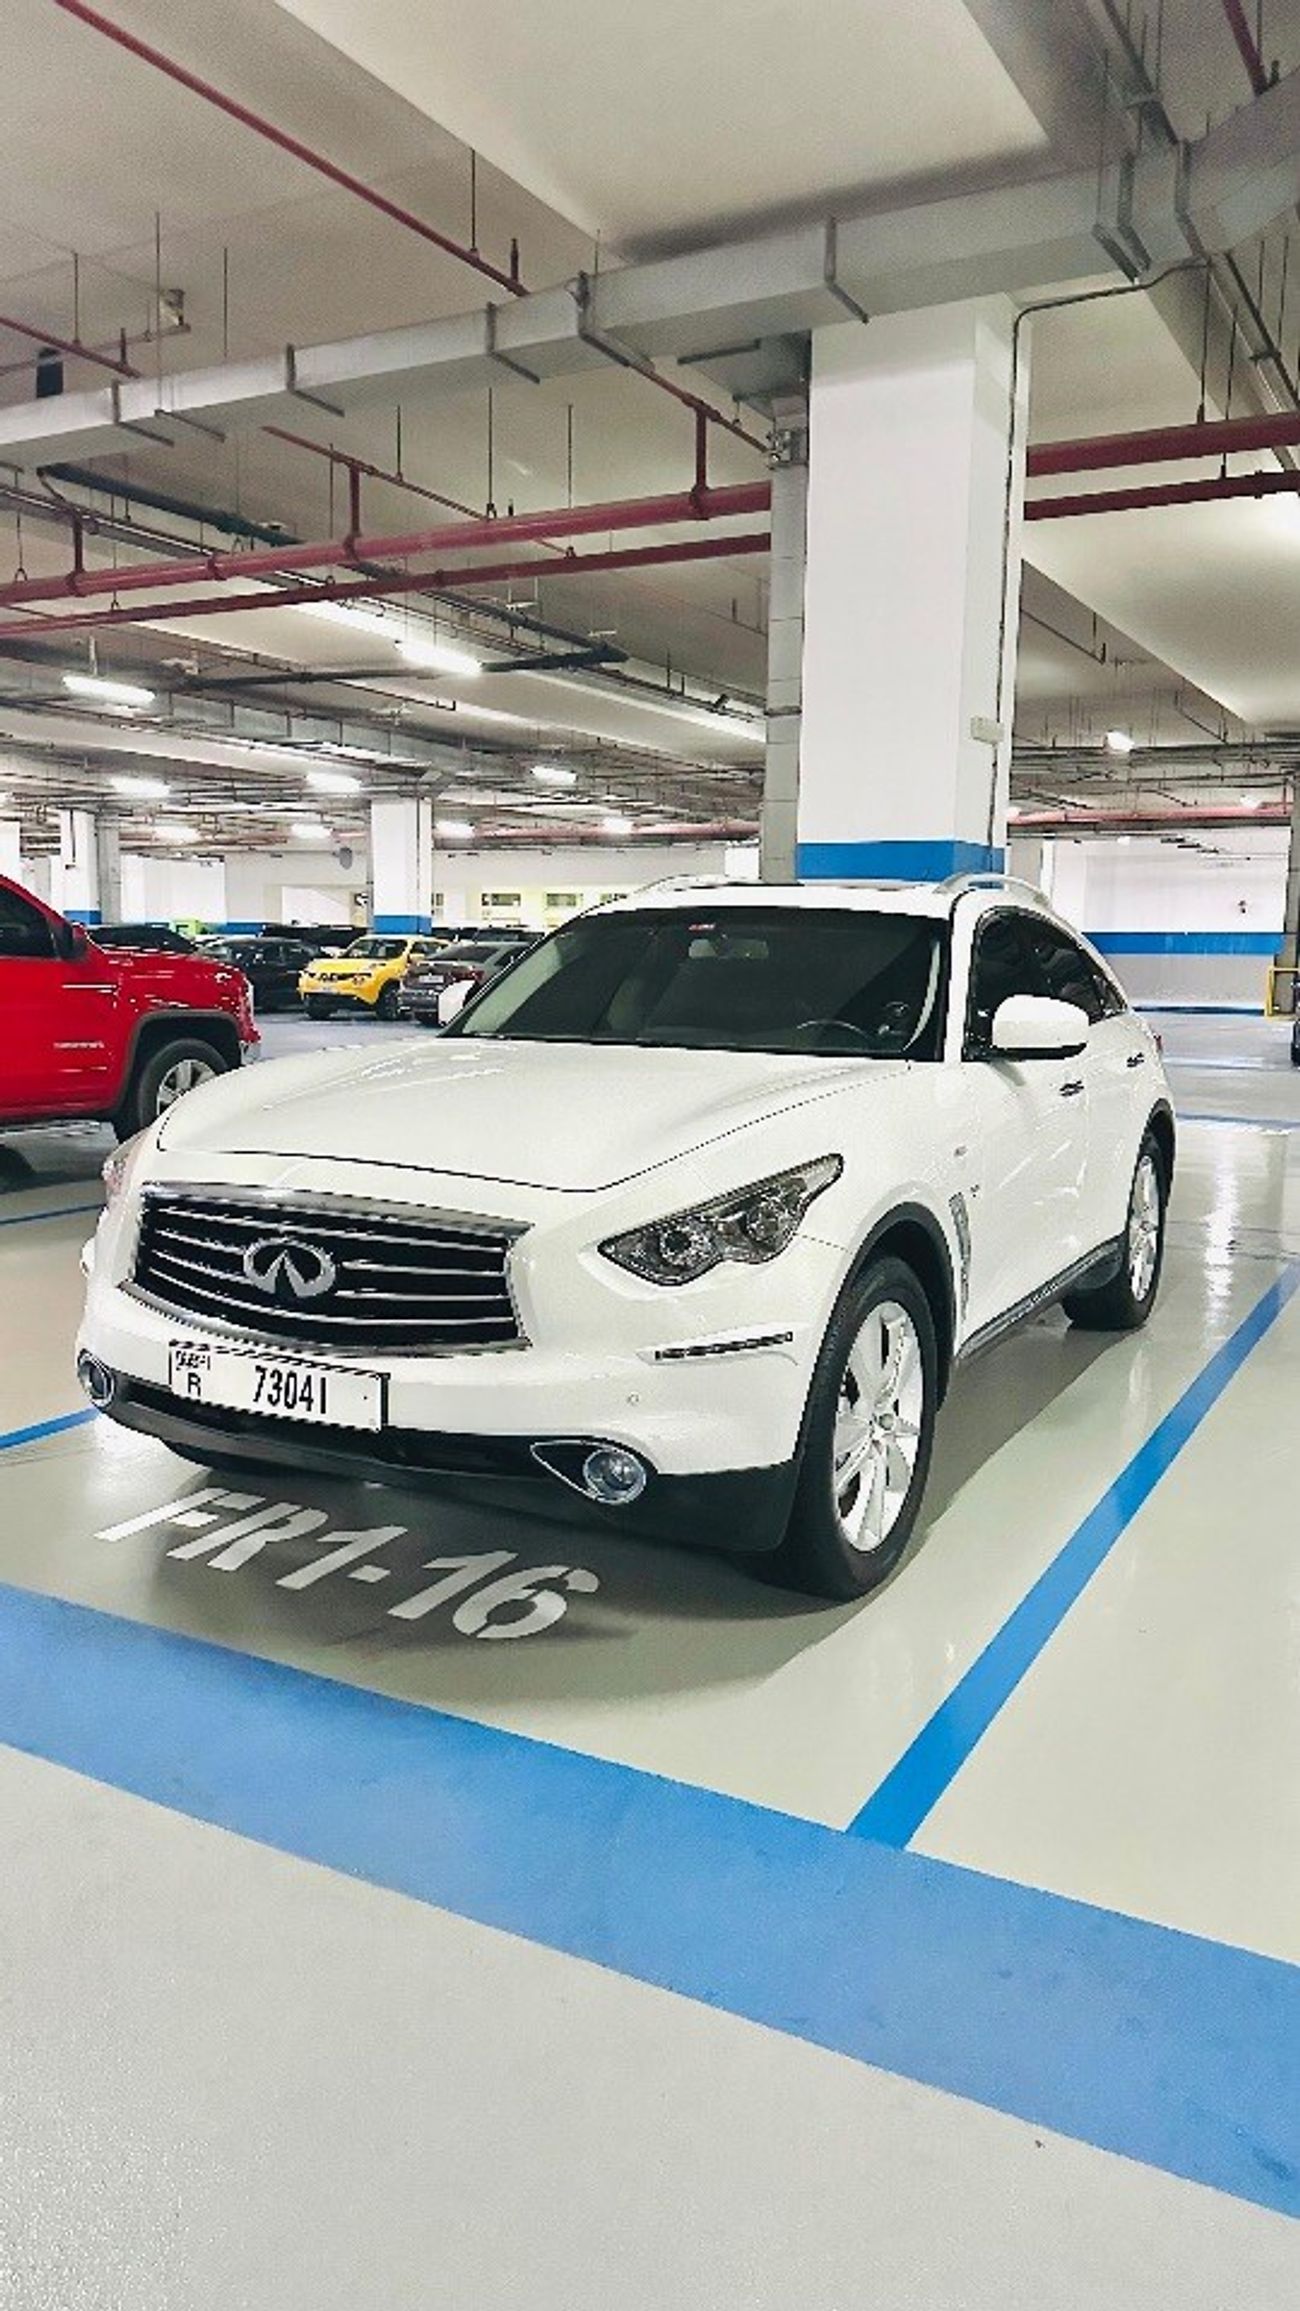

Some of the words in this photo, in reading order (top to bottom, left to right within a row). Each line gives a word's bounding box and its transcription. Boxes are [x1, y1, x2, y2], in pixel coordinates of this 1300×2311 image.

[187, 1372, 201, 1397] R
[253, 1364, 327, 1415] 73041
[94, 1487, 599, 1639] FR1-16
